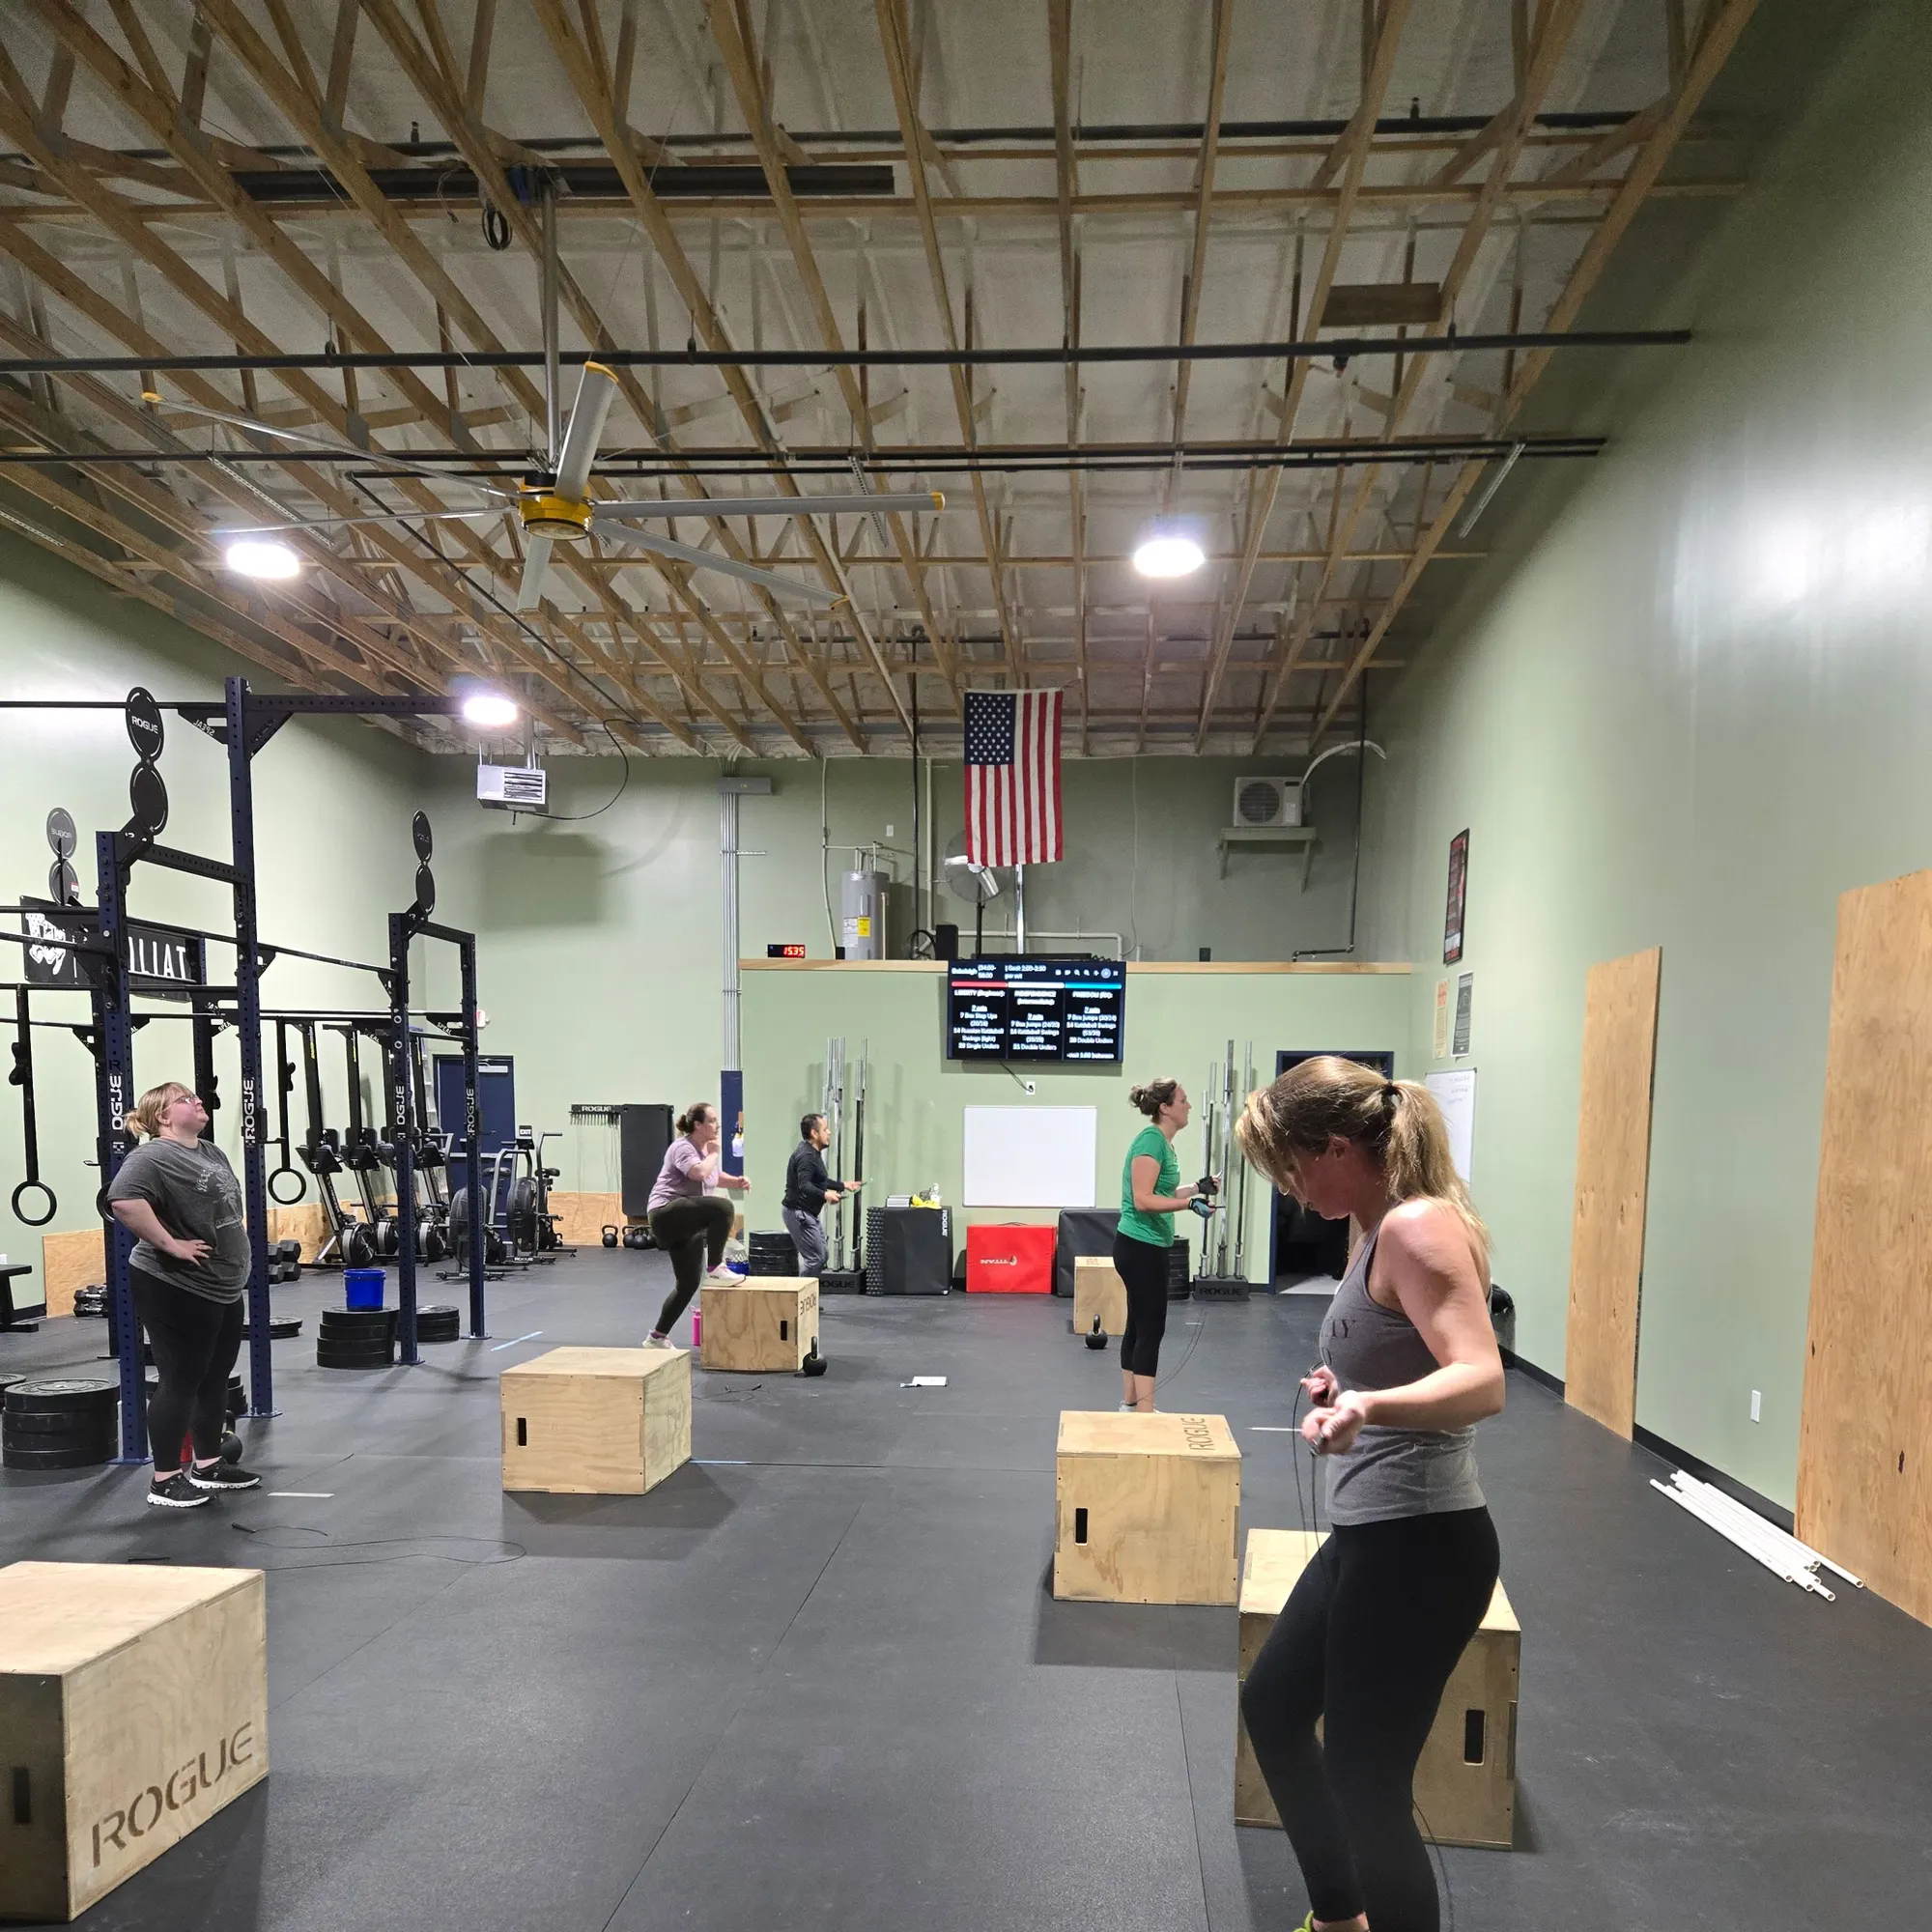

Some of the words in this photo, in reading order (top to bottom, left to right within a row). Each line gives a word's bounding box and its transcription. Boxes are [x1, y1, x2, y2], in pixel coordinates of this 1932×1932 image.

[131, 715, 158, 734] ROGUE
[243, 1079, 256, 1140] ROGUE
[467, 1088, 475, 1134] ROGUE
[819, 1280, 857, 1289] OGUE
[1199, 1287, 1245, 1297] ROGUE
[1180, 1416, 1215, 1451] ROGUE
[91, 1720, 253, 1869] ROGUE
